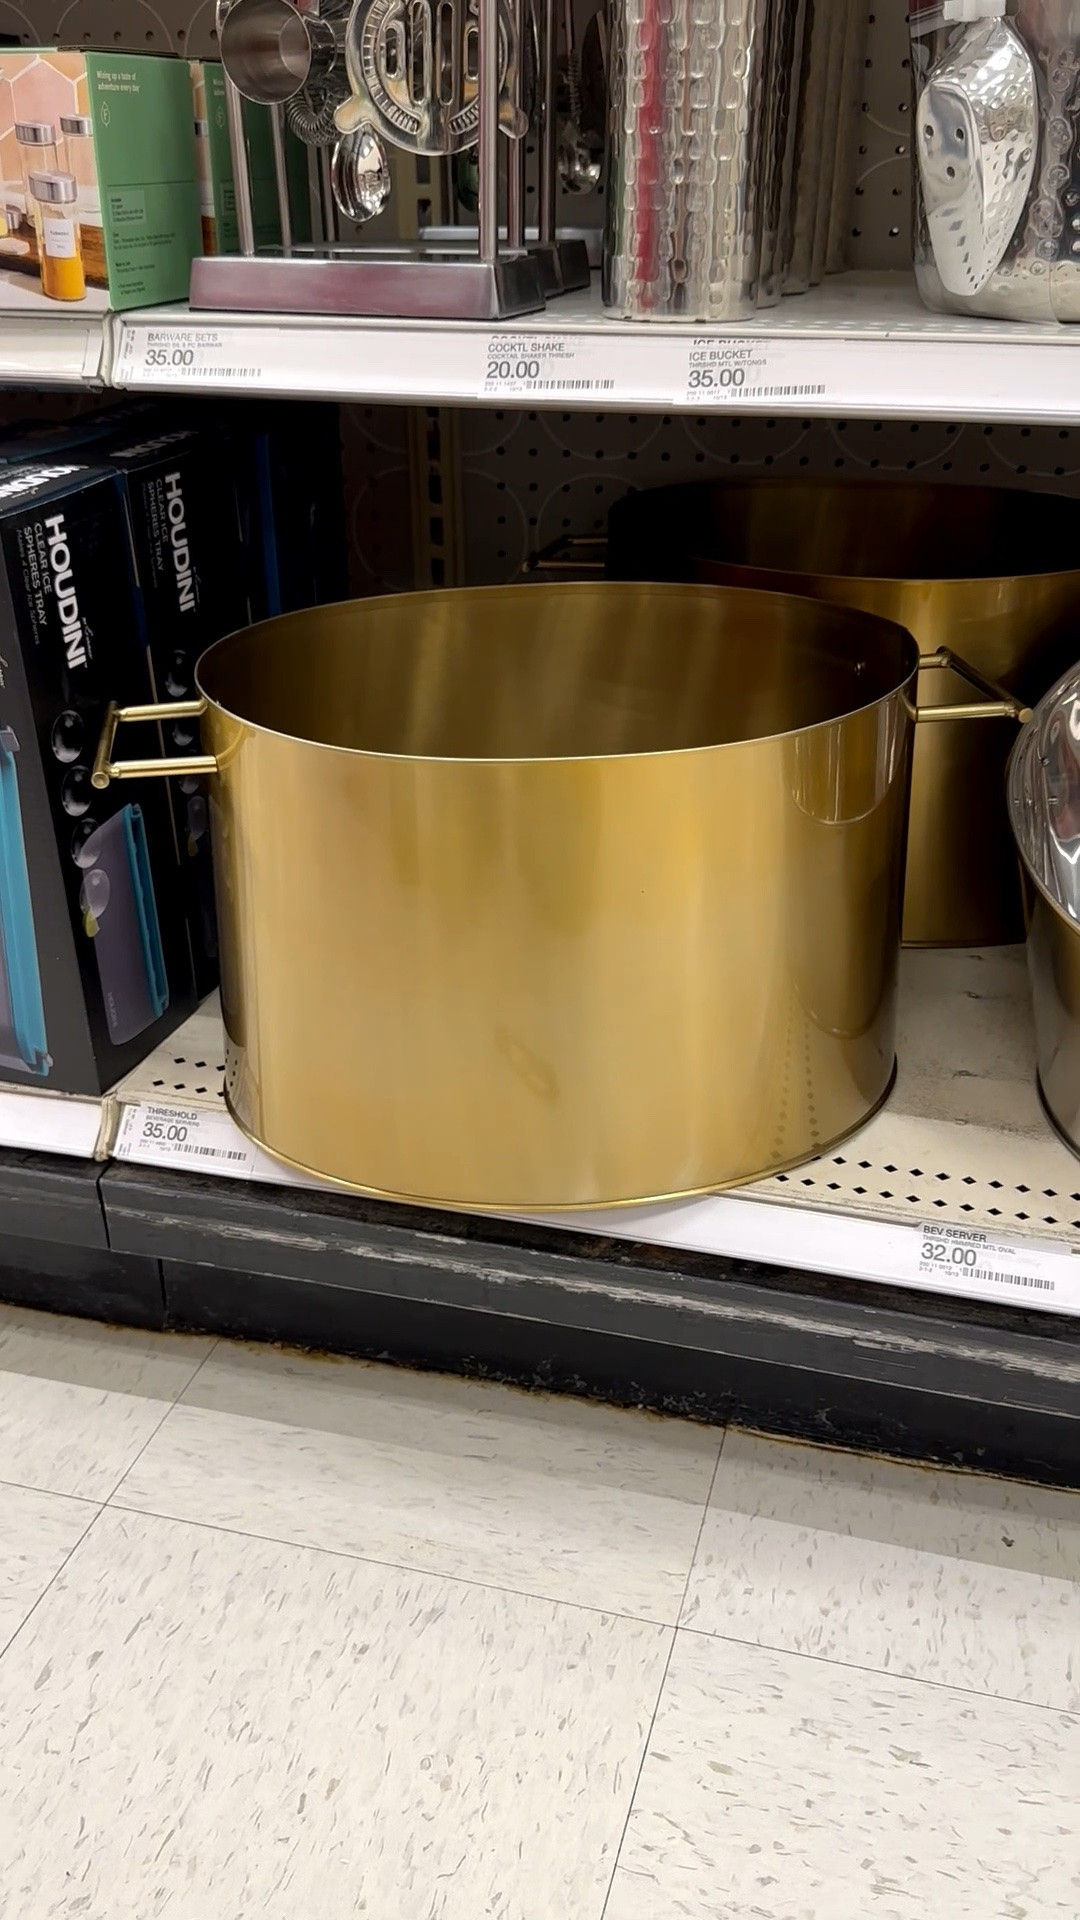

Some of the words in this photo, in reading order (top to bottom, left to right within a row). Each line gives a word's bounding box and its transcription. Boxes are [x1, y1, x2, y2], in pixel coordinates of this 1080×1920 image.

[147, 332, 193, 342] BARWARE
[195, 333, 218, 342] SETS
[145, 349, 194, 366] 35.00
[488, 343, 528, 353] COCKTL
[530, 343, 565, 352] SHAKE
[689, 352, 707, 361] ICE
[709, 350, 753, 360] BUCKET
[486, 361, 540, 379] 20.00
[688, 369, 745, 388] 35.00
[156, 479, 167, 521] CLEAR
[148, 481, 160, 538] SPHERES
[155, 540, 164, 571] TRAY
[161, 522, 169, 543] ICE
[165, 472, 196, 612] HOUDINI
[33, 522, 48, 570] CLEAR
[42, 571, 52, 595] ICE
[23, 568, 31, 592] Clear
[24, 526, 41, 589] SPHERES
[34, 590, 47, 626] TRAY
[44, 513, 87, 669] HOUDINI
[147, 1106, 198, 1121] THRESHOLD
[143, 1121, 188, 1142] 35.00
[923, 1225, 944, 1236] BEV
[945, 1229, 987, 1243] SERVER
[921, 1242, 977, 1267] 32.00
[982, 1244, 997, 1252] MTL
[998, 1246, 1017, 1255] OVAL
